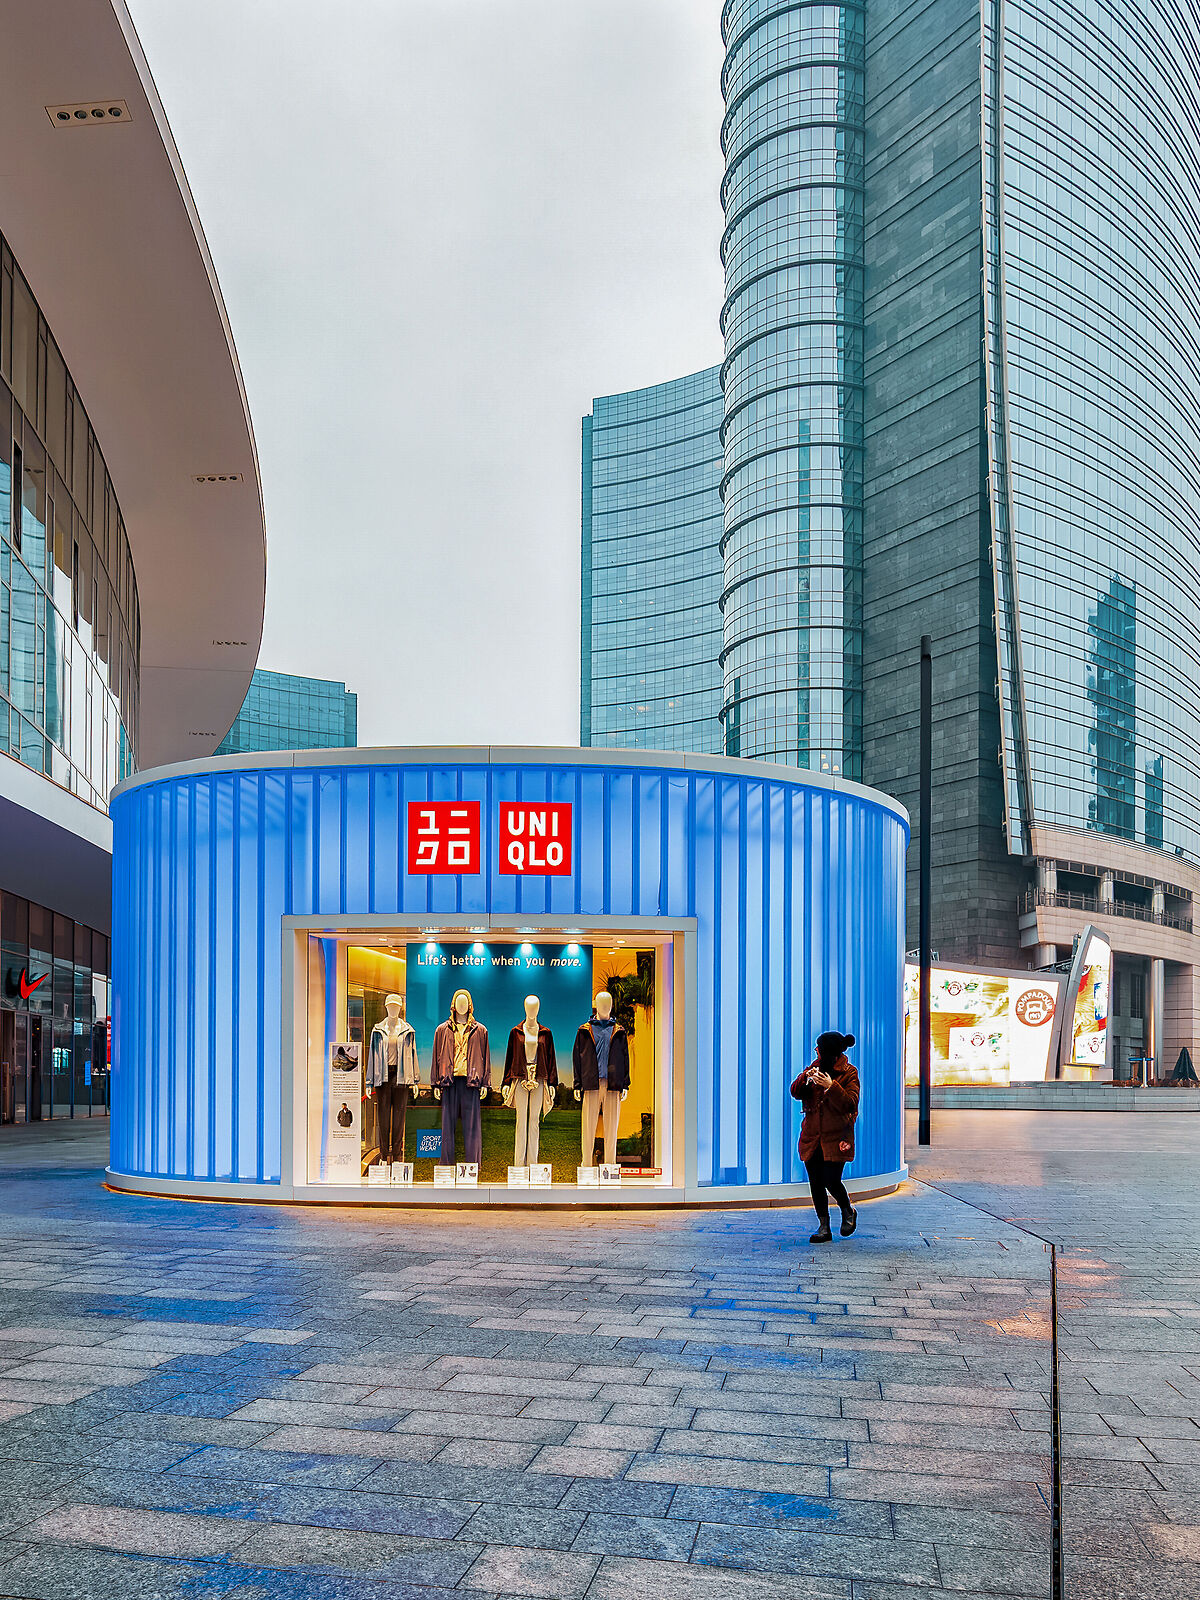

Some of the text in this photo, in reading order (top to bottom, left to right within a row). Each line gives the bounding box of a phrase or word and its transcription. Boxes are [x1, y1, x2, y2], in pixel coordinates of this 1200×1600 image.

[417, 810, 471, 835] ユニ
[507, 811, 559, 837] UNI
[415, 840, 471, 865] クロ
[507, 840, 564, 871] QLO
[417, 954, 582, 969] Life's better when you move.
